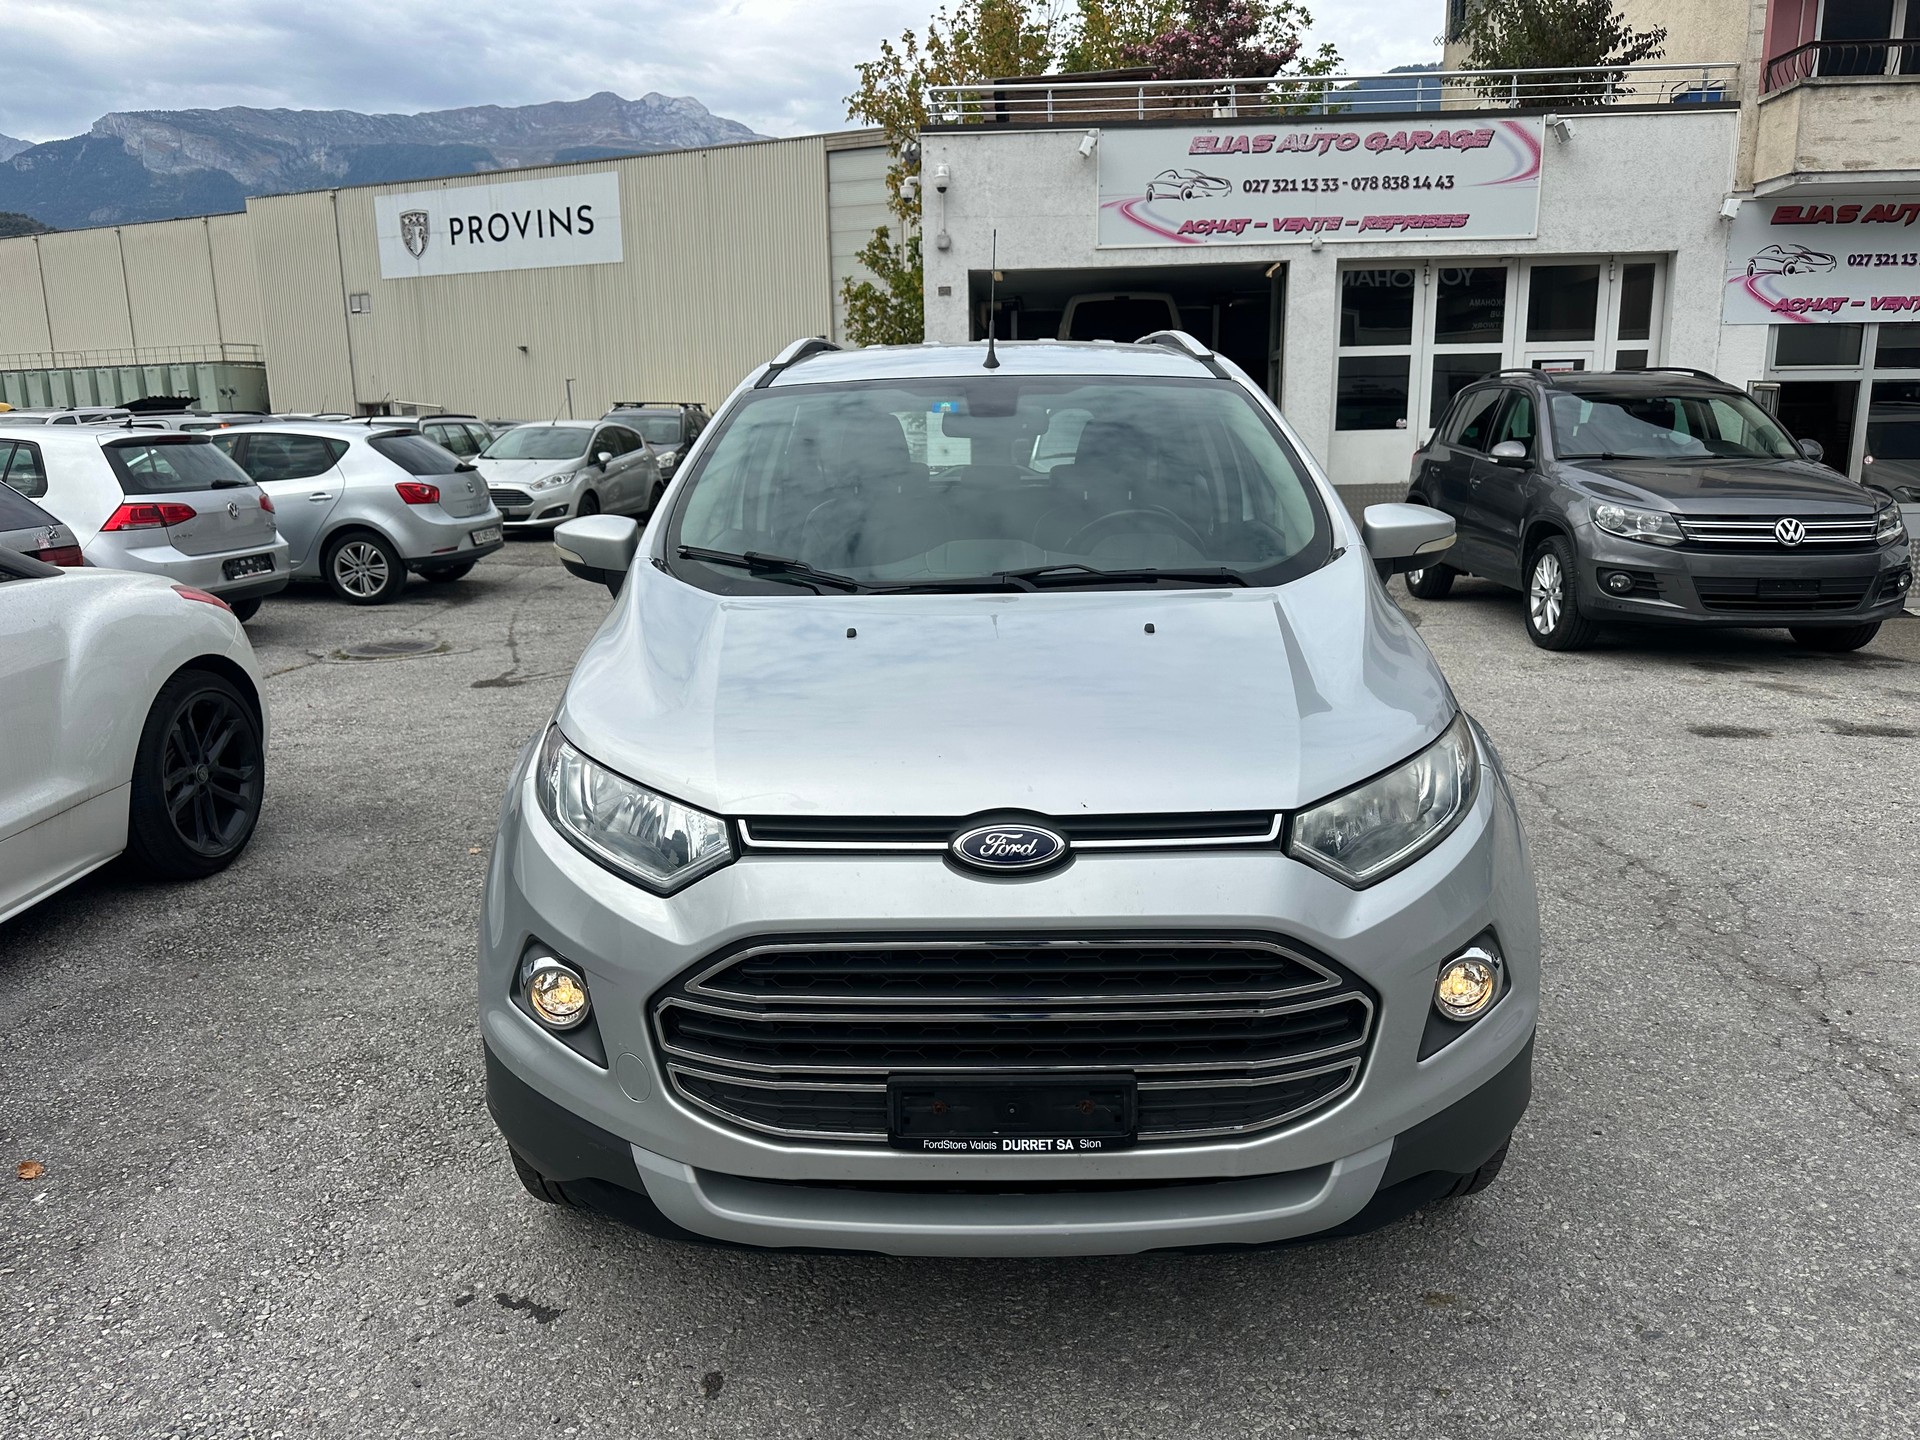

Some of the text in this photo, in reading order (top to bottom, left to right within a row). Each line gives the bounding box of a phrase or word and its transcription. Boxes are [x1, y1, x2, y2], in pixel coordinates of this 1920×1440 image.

[1188, 128, 1496, 156] ELIAS AUTO GARAGE
[1242, 179, 1270, 193] 027
[1272, 178, 1298, 193] 321
[1301, 178, 1319, 192] 13
[1321, 178, 1339, 192] 33
[1351, 176, 1379, 191] 078
[1381, 175, 1410, 190] 838
[1412, 175, 1432, 190] 14
[1434, 174, 1455, 189] 43
[449, 205, 594, 246] PROVINS
[1177, 218, 1252, 236] ACHAT
[1272, 216, 1343, 235] VENTE
[1358, 213, 1470, 233] REPRISES
[1770, 204, 1863, 226] ELIAS
[1847, 253, 1918, 267] 027 321 13
[1771, 296, 1850, 314] ACHAT
[979, 832, 1038, 857] Ford
[923, 1138, 1102, 1151] FordStore Valais DURRET SA Sion
